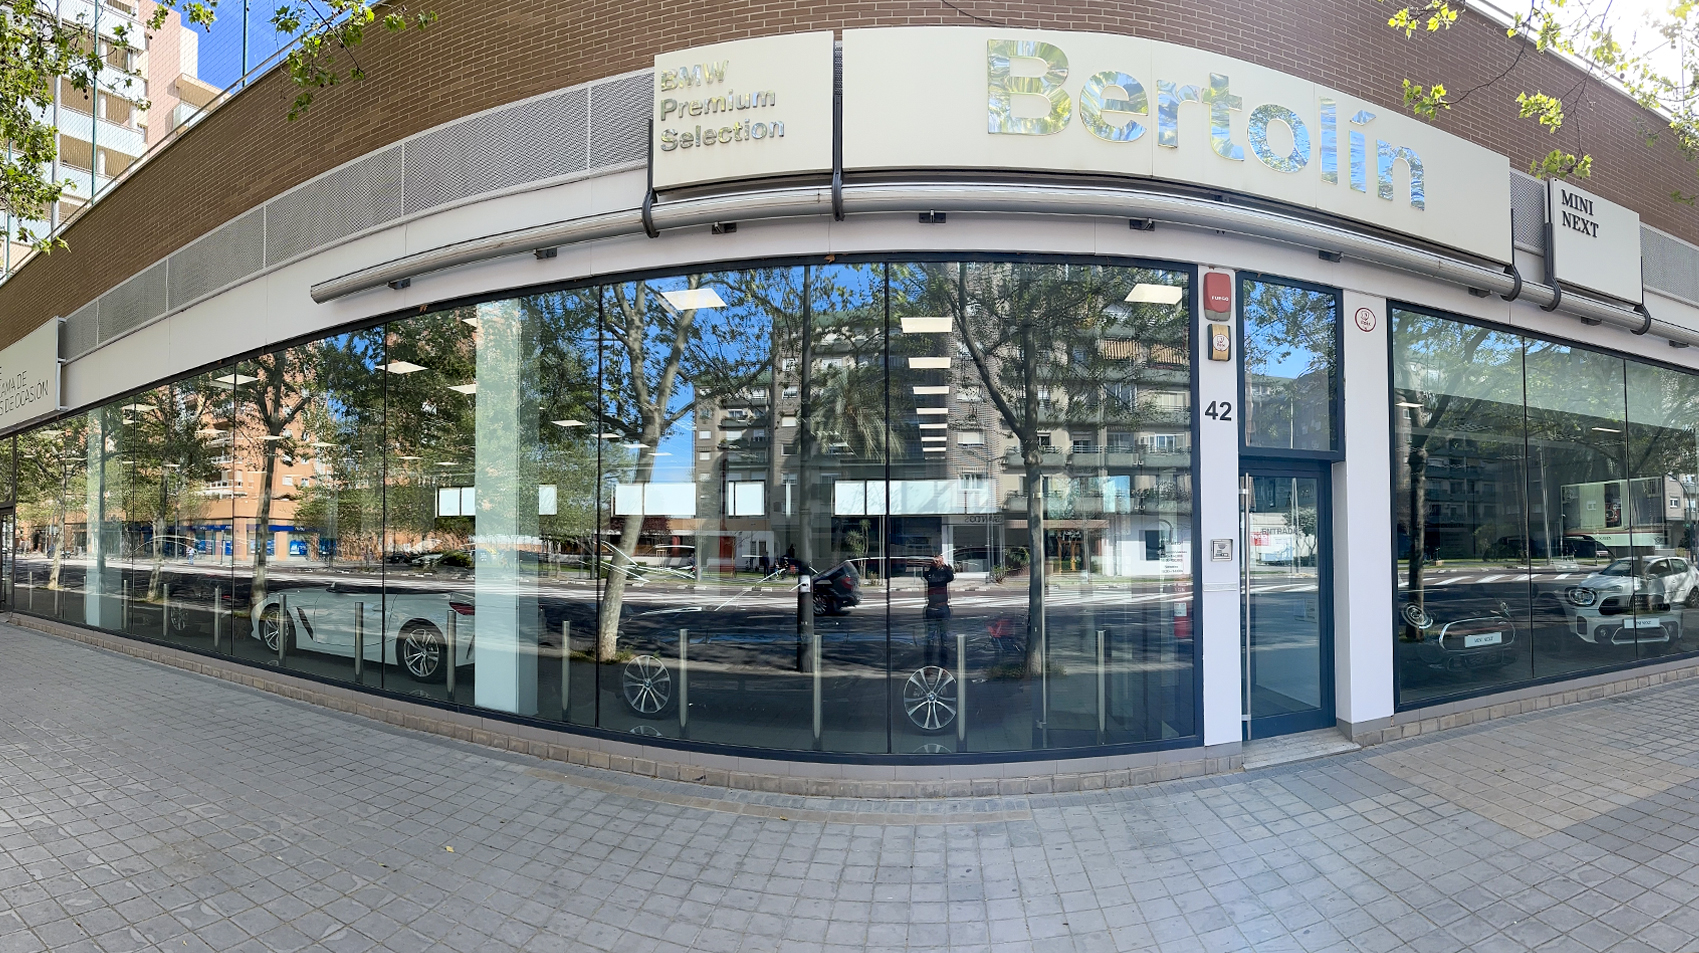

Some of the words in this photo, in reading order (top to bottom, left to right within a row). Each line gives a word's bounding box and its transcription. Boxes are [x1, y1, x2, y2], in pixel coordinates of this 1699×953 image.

[660, 60, 729, 92] BMW
[660, 89, 776, 121] Premium
[660, 118, 785, 152] Selection
[986, 38, 1426, 212] Bertolín
[1561, 188, 1594, 216] MINI
[1562, 210, 1599, 238] NEXT
[0, 377, 16, 399] AMA
[16, 370, 27, 390] DE
[5, 396, 14, 413] DE
[14, 379, 49, 409] OCASIÓN
[1204, 400, 1232, 421] 42
